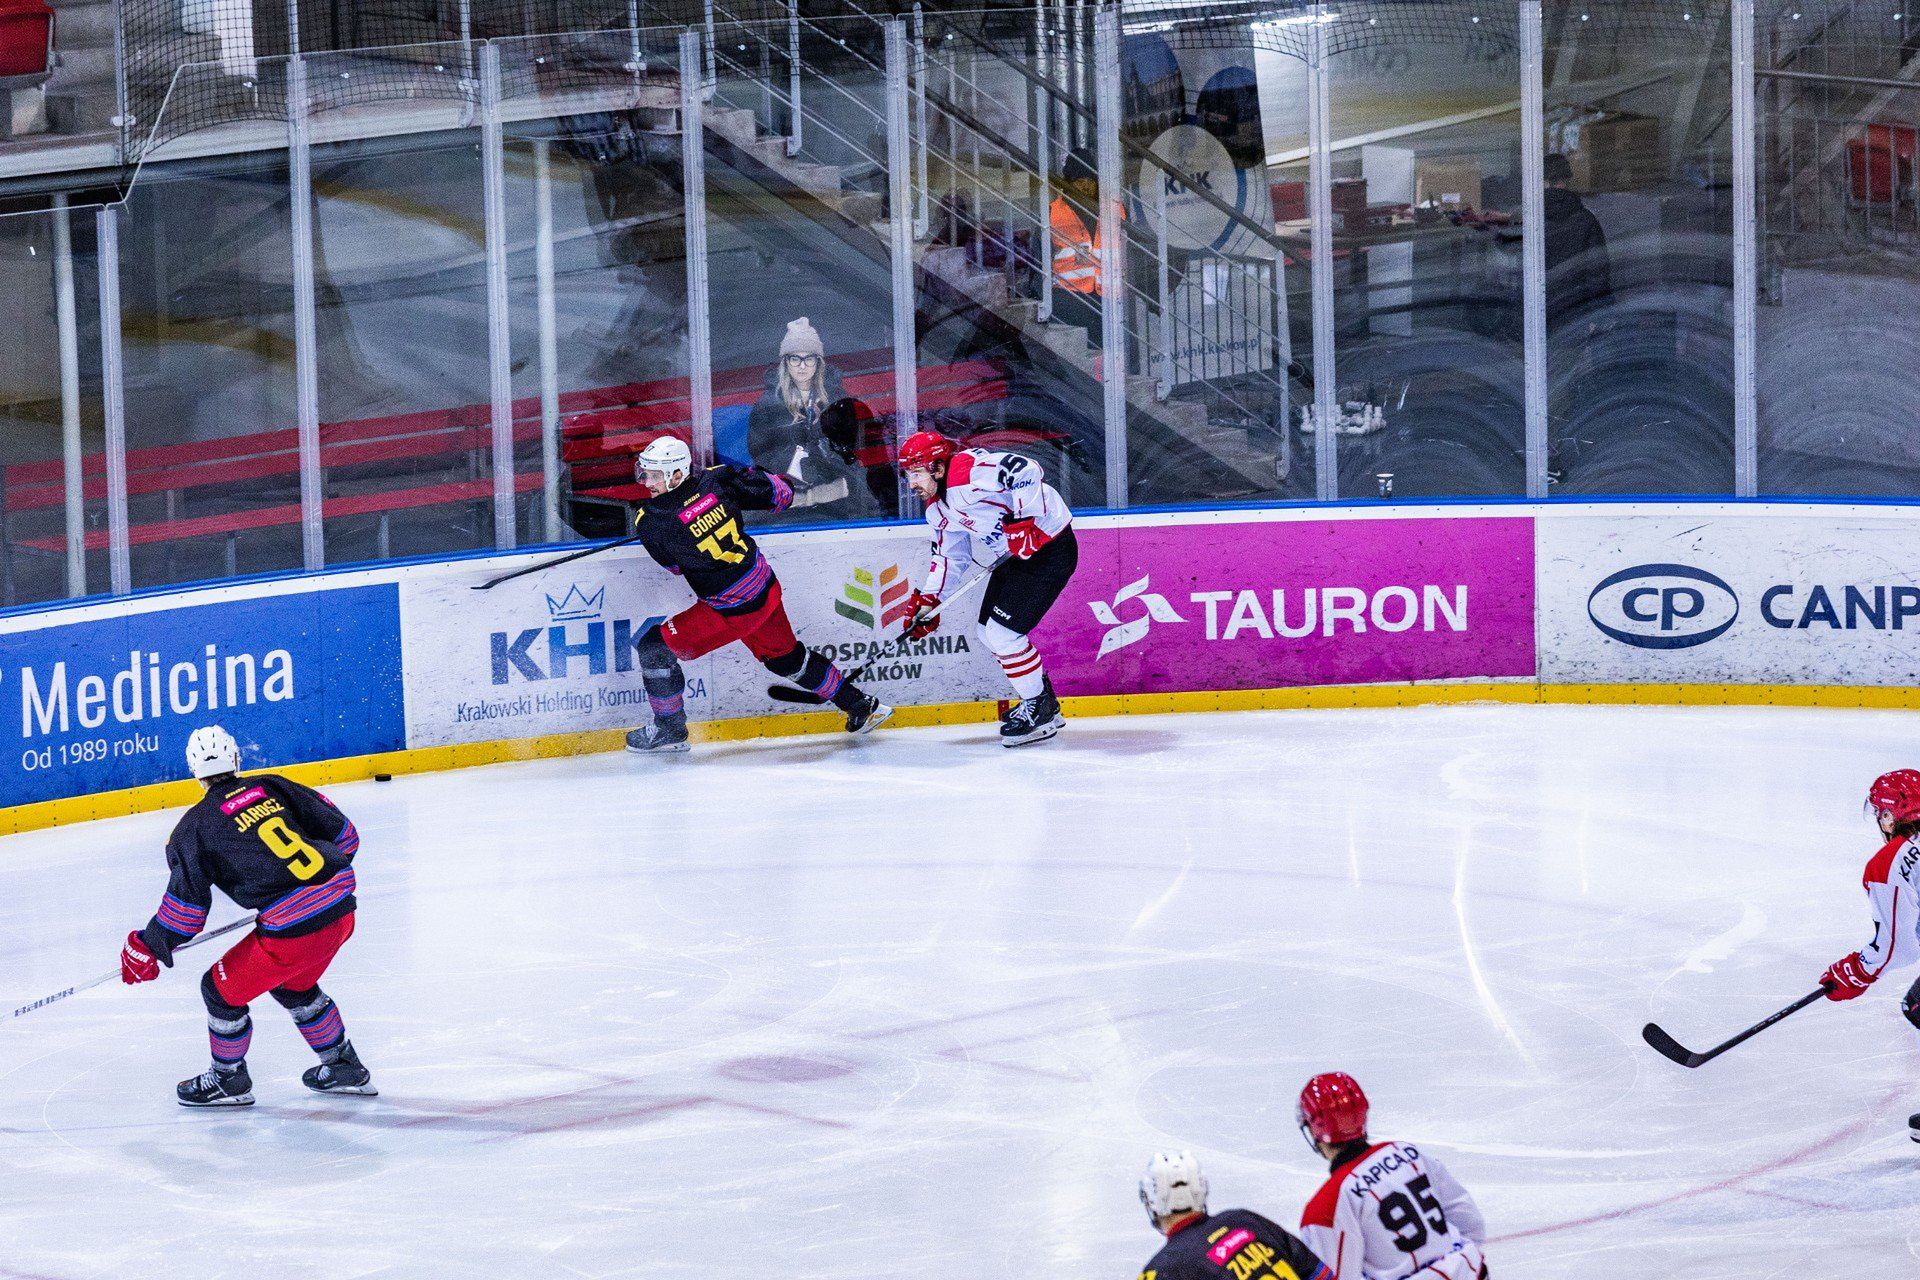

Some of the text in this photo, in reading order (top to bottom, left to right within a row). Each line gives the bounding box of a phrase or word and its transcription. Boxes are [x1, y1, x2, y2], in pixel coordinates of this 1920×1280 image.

[689, 504, 728, 538] GÓRNY
[1190, 585, 1468, 640] TAURON
[21, 644, 294, 738] Medicina
[457, 696, 532, 723] Krakowski
[536, 689, 593, 714] Holding
[687, 678, 707, 698] SA
[22, 733, 159, 771] Od 1989 roku
[234, 798, 285, 833] JAROSZ
[257, 816, 325, 881] 9
[1378, 1173, 1448, 1253] 95
